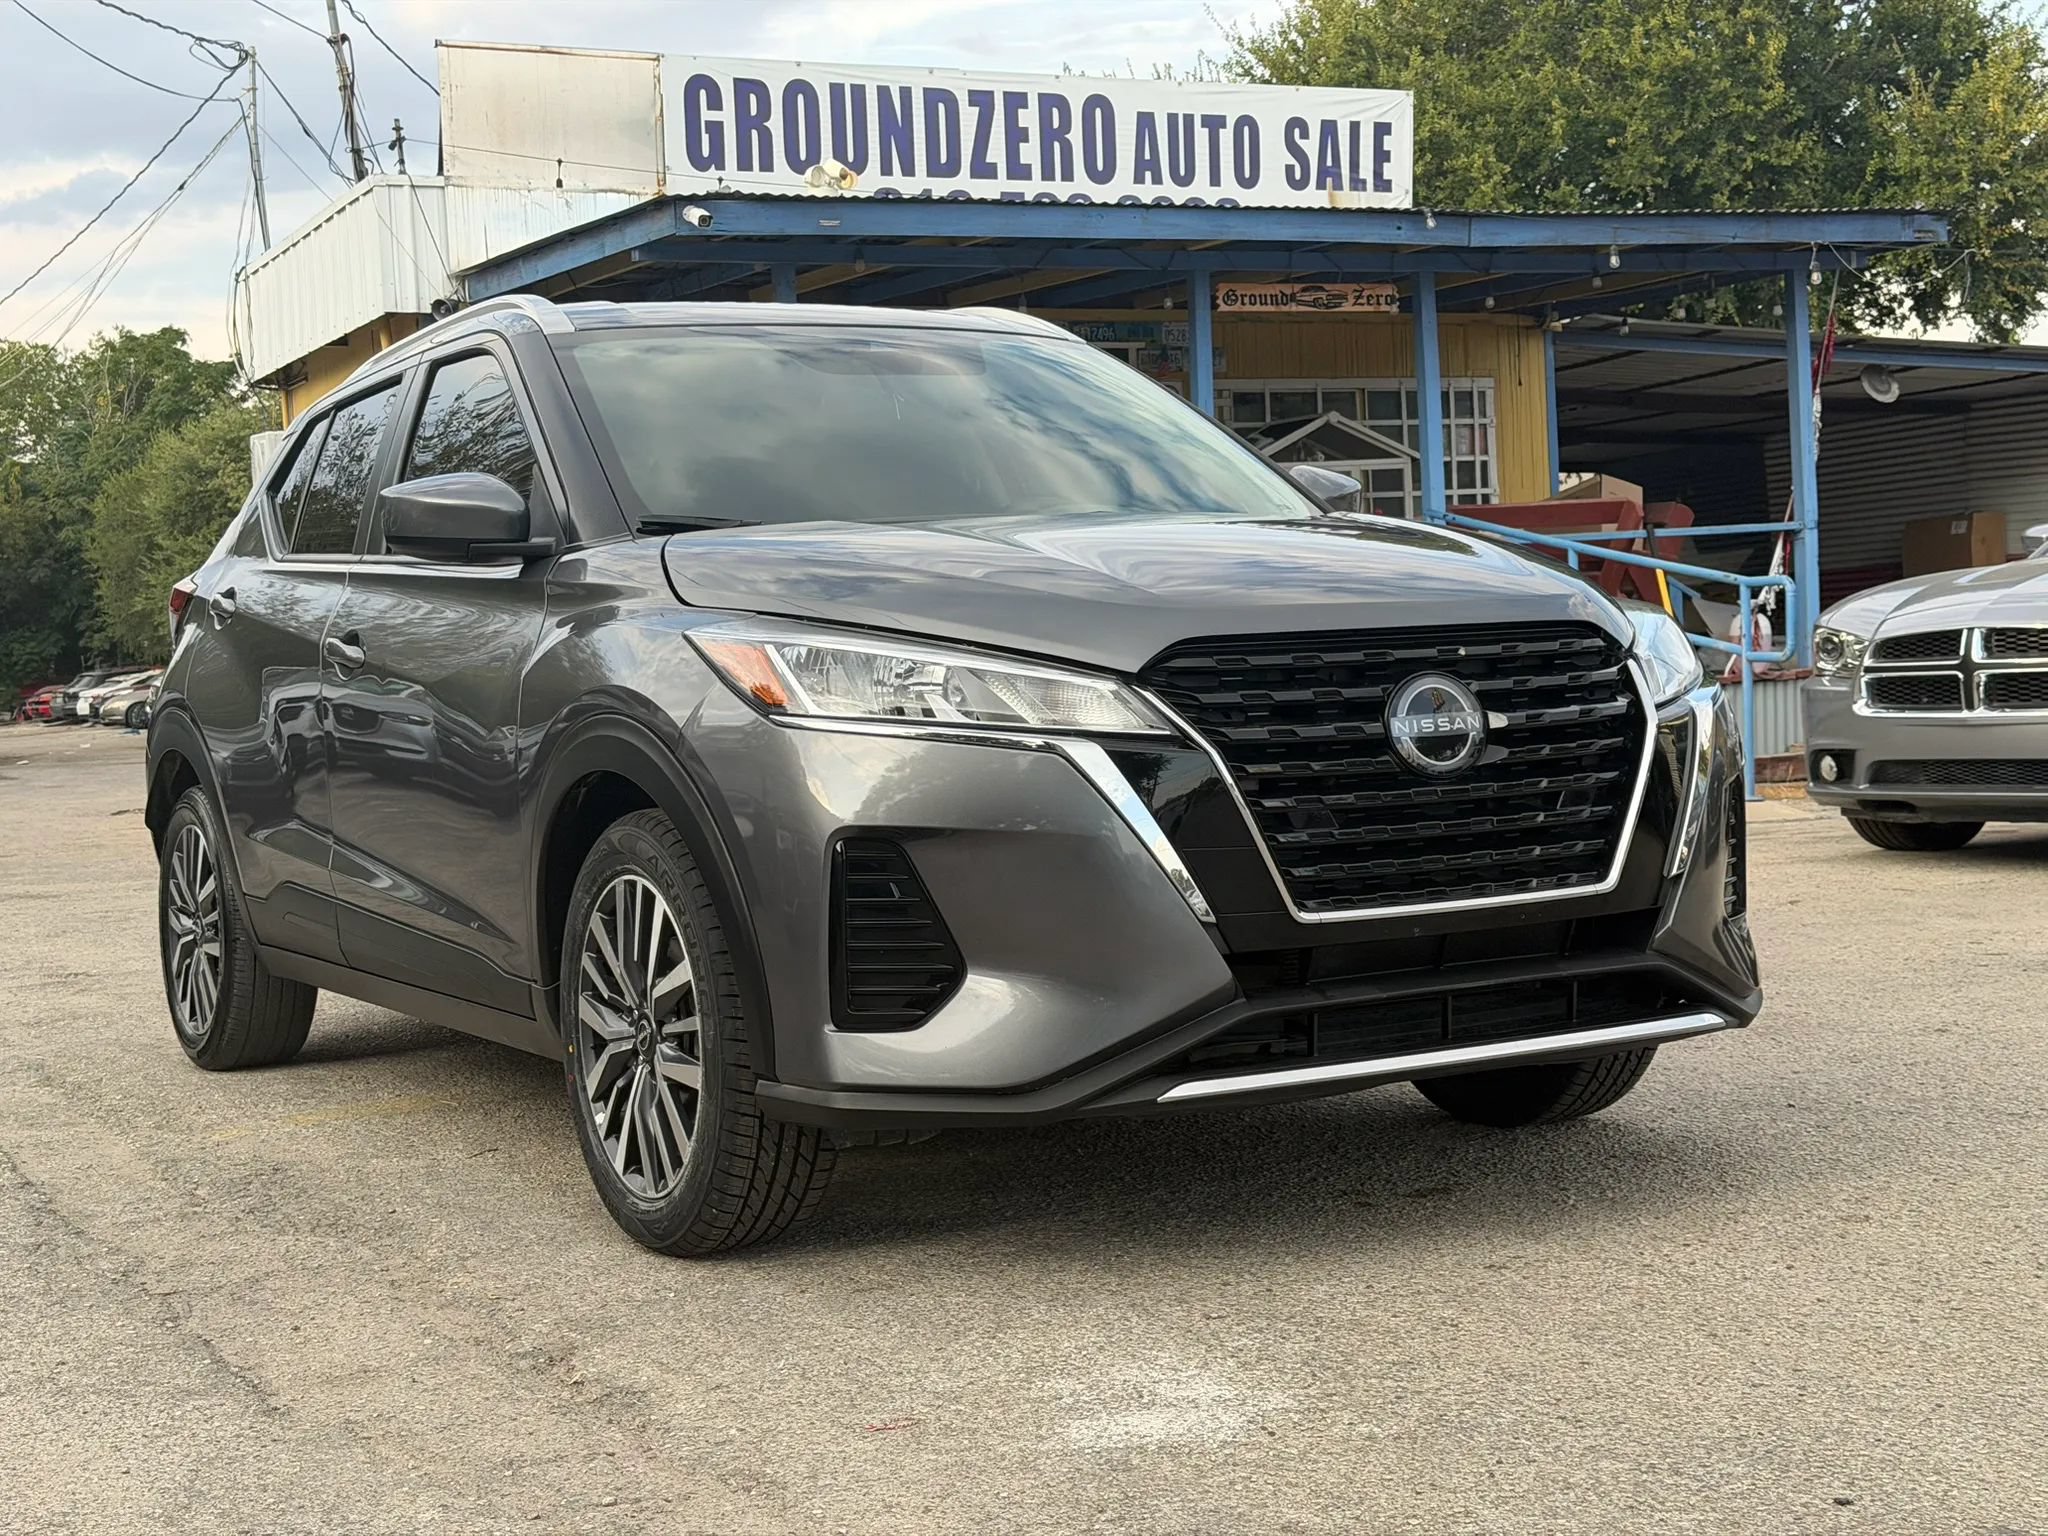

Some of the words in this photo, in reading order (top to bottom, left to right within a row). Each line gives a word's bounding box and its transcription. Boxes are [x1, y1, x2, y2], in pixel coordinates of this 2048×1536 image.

[684, 73, 1117, 185] GROUNDZERO
[1133, 110, 1260, 190] AUTO
[1284, 115, 1393, 194] SALE
[1222, 289, 1292, 307] Ground
[1352, 288, 1395, 307] Zero
[1393, 715, 1480, 734] NISSAN
